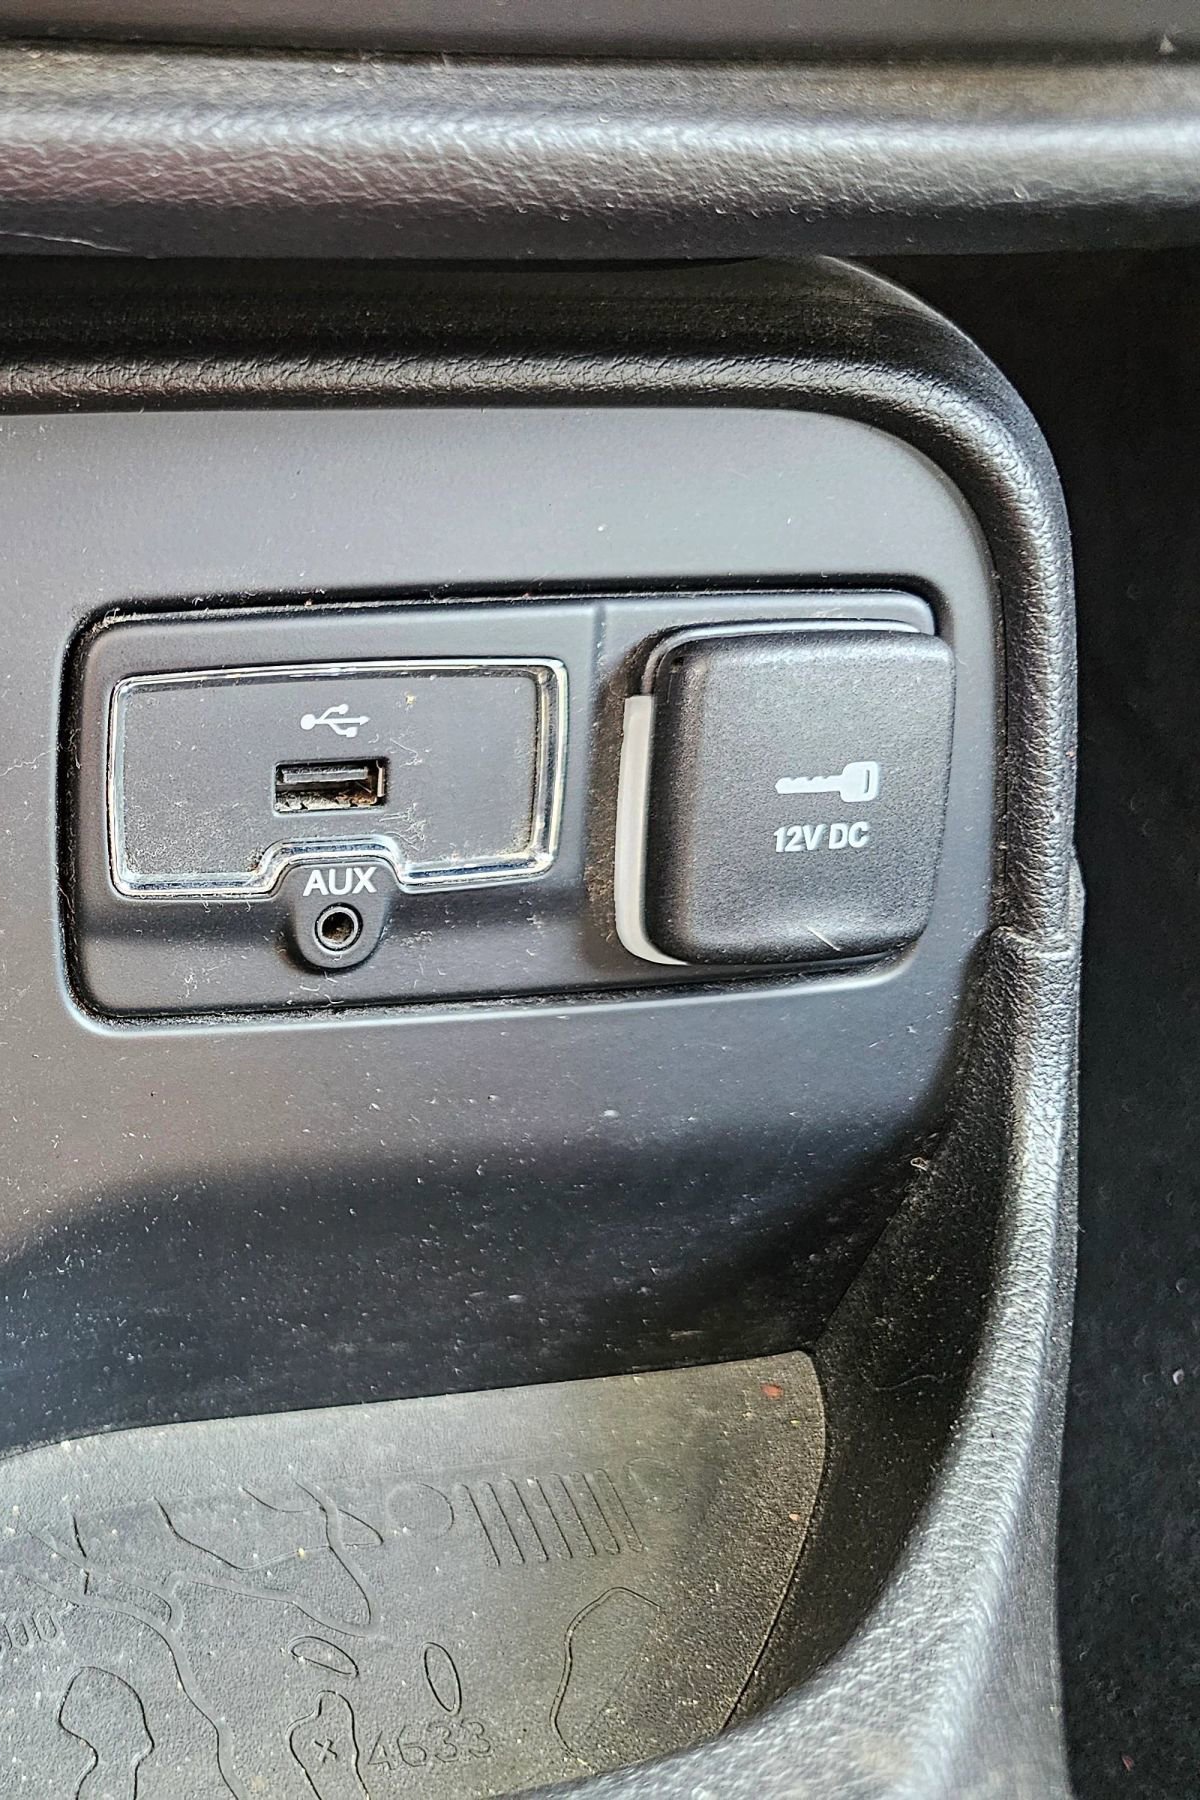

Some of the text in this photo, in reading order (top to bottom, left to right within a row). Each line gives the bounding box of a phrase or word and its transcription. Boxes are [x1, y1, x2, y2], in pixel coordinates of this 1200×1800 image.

[773, 821, 870, 853] 12V DC
[302, 866, 378, 897] AUX
[366, 1718, 494, 1770] 4633
